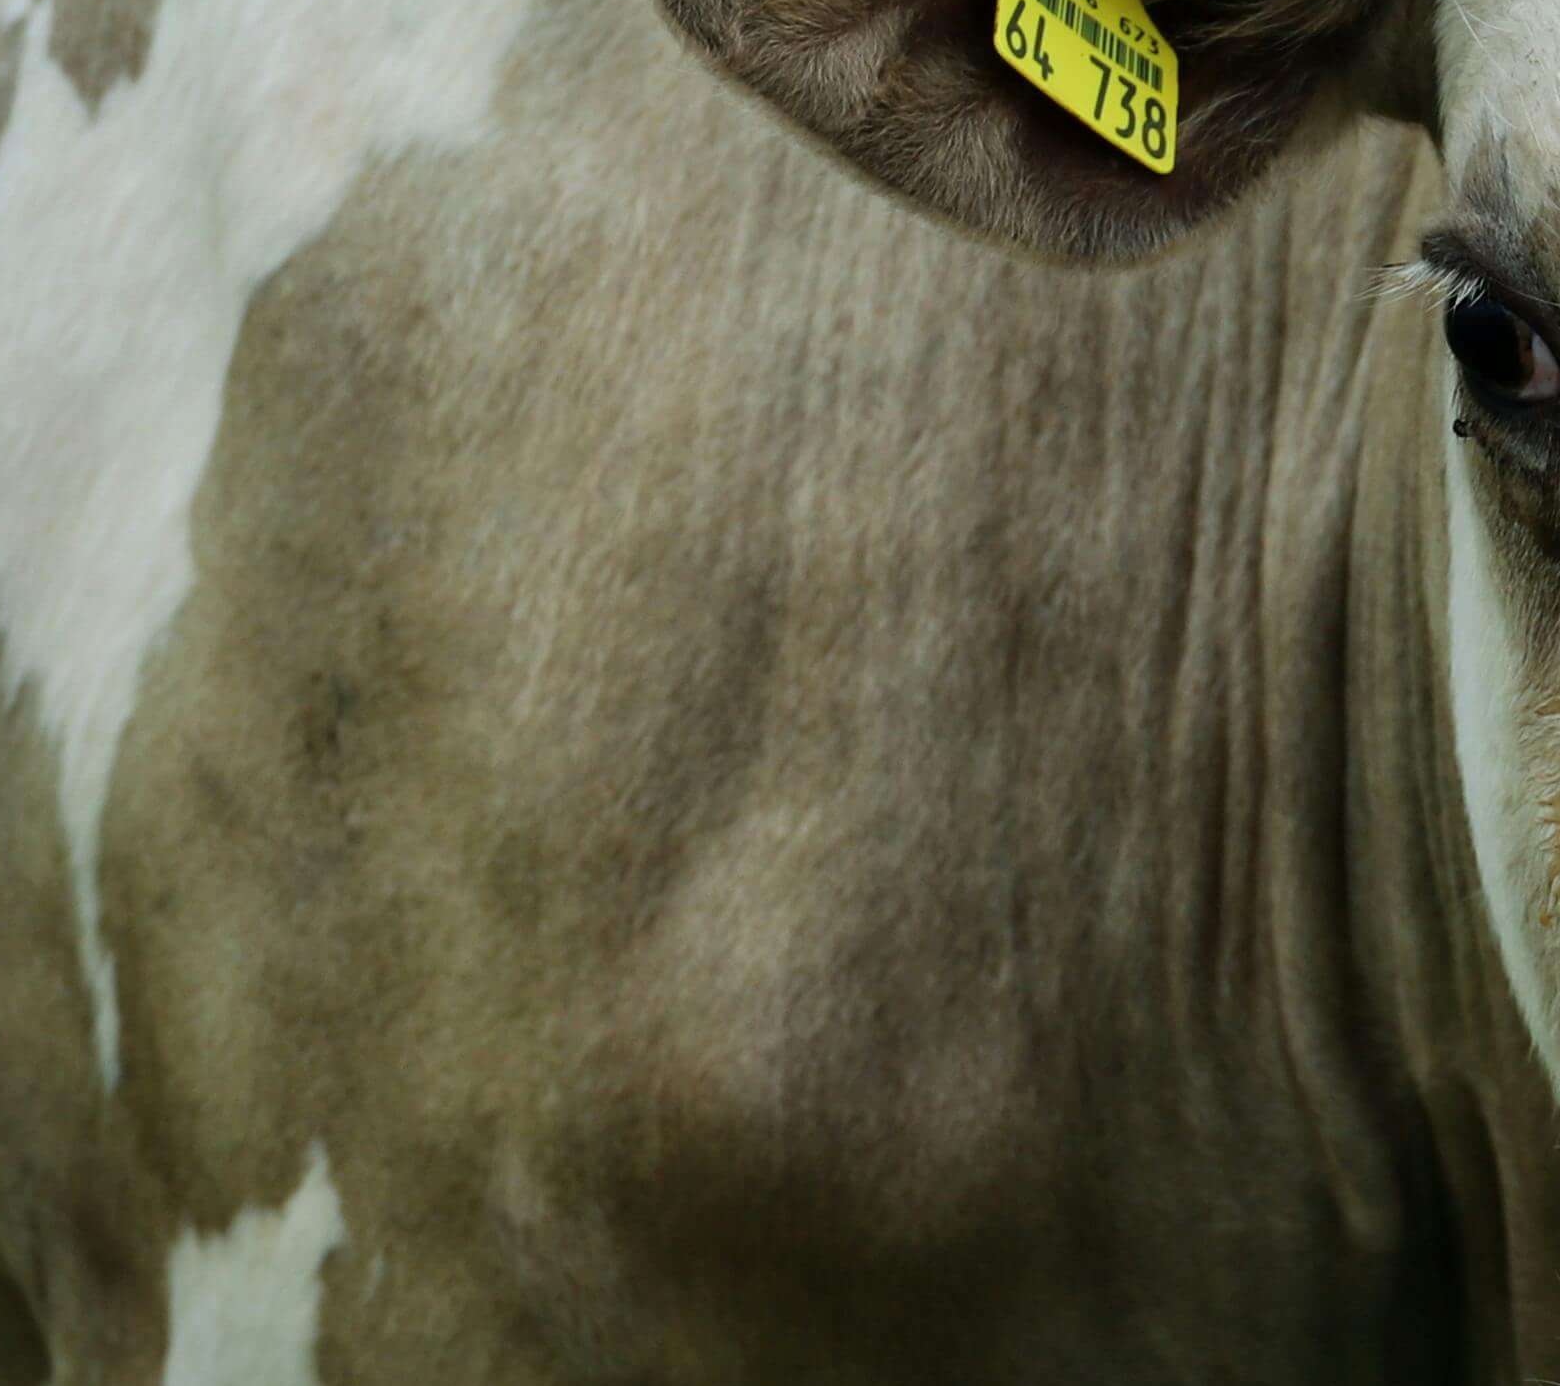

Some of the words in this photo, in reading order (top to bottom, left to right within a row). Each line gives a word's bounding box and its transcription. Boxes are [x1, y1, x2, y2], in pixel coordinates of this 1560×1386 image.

[1006, 0, 1054, 81] 64
[1090, 55, 1167, 160] 738
[1119, 16, 1159, 55] 673
